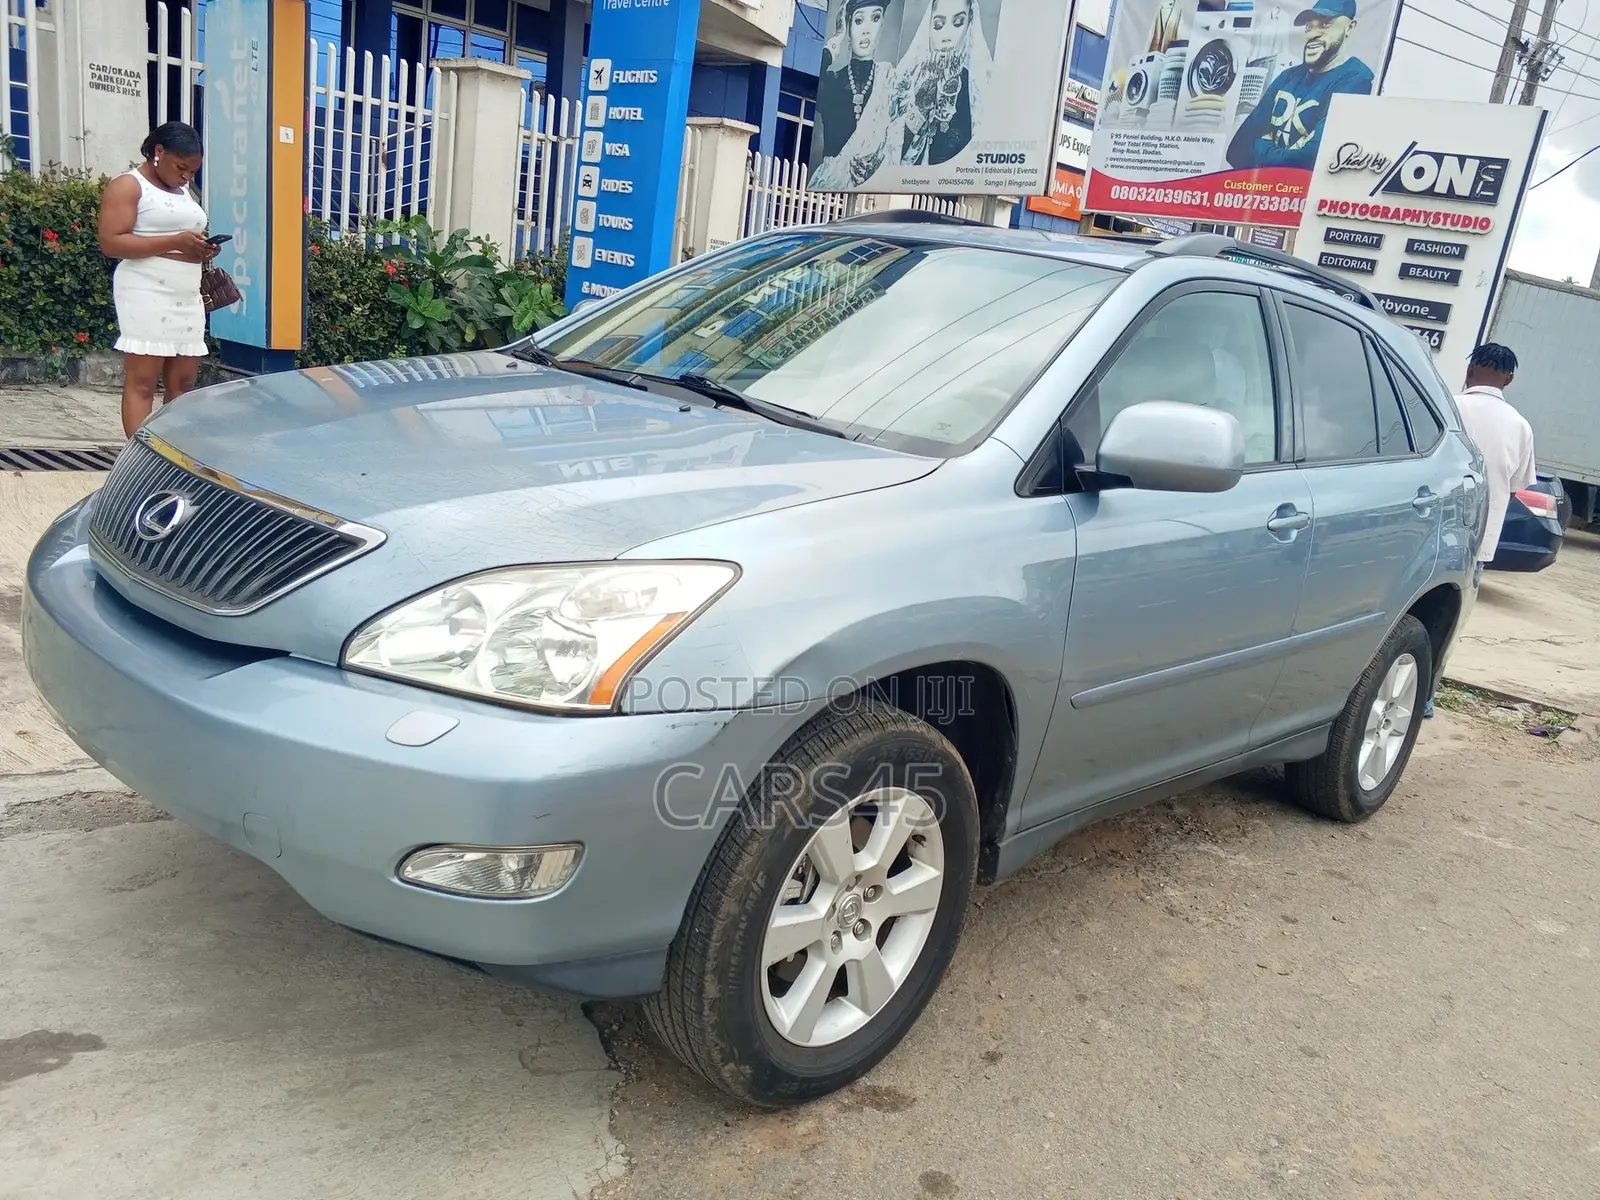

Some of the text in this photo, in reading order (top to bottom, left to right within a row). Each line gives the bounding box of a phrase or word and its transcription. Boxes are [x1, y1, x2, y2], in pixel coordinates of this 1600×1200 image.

[634, 0, 670, 8] Centre
[251, 39, 259, 72] LTE
[89, 63, 141, 80] CAR/OKADA
[612, 70, 658, 84] FLIGHTS
[608, 107, 644, 120] HOTEL
[605, 142, 630, 157] VISA
[1058, 134, 1091, 156] JPS Expre
[976, 153, 1026, 164] STUDIOS
[955, 166, 1038, 175] Portraits Editorials Events
[601, 179, 633, 193] RIDES
[901, 179, 930, 187] Shotbyone
[984, 179, 1003, 188] Sango
[1008, 180, 1037, 188] Ringroad
[1224, 179, 1303, 194] Customer Care:
[1110, 185, 1211, 207] 08032039631,
[598, 214, 633, 231] TOURS
[1329, 230, 1379, 245] PORTRAIT
[1413, 242, 1460, 256] FASHION
[595, 248, 635, 267] EVENTS
[1321, 255, 1373, 271] EDITORIAL
[1409, 267, 1450, 280] BEAUTY
